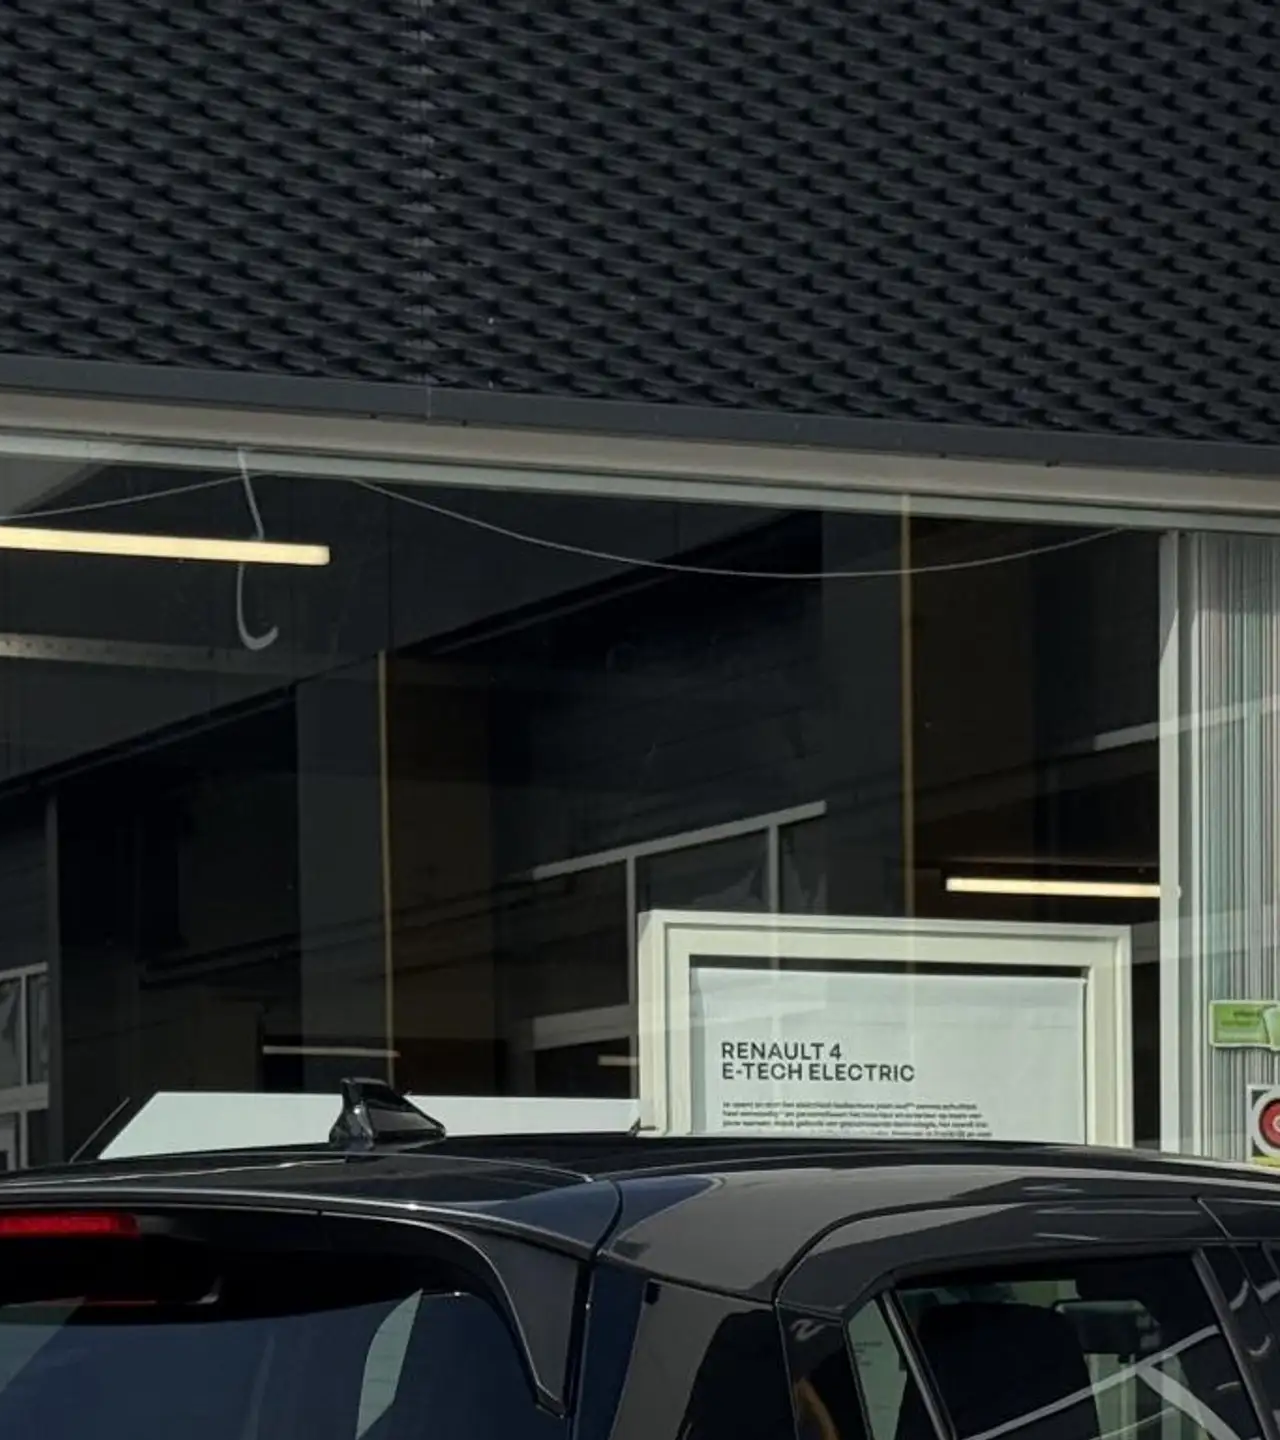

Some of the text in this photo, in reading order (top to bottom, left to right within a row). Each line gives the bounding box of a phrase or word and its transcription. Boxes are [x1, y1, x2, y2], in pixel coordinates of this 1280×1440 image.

[721, 1042, 842, 1061] RENAULT 4
[722, 1063, 915, 1081] E-TECH ELECTRIC
